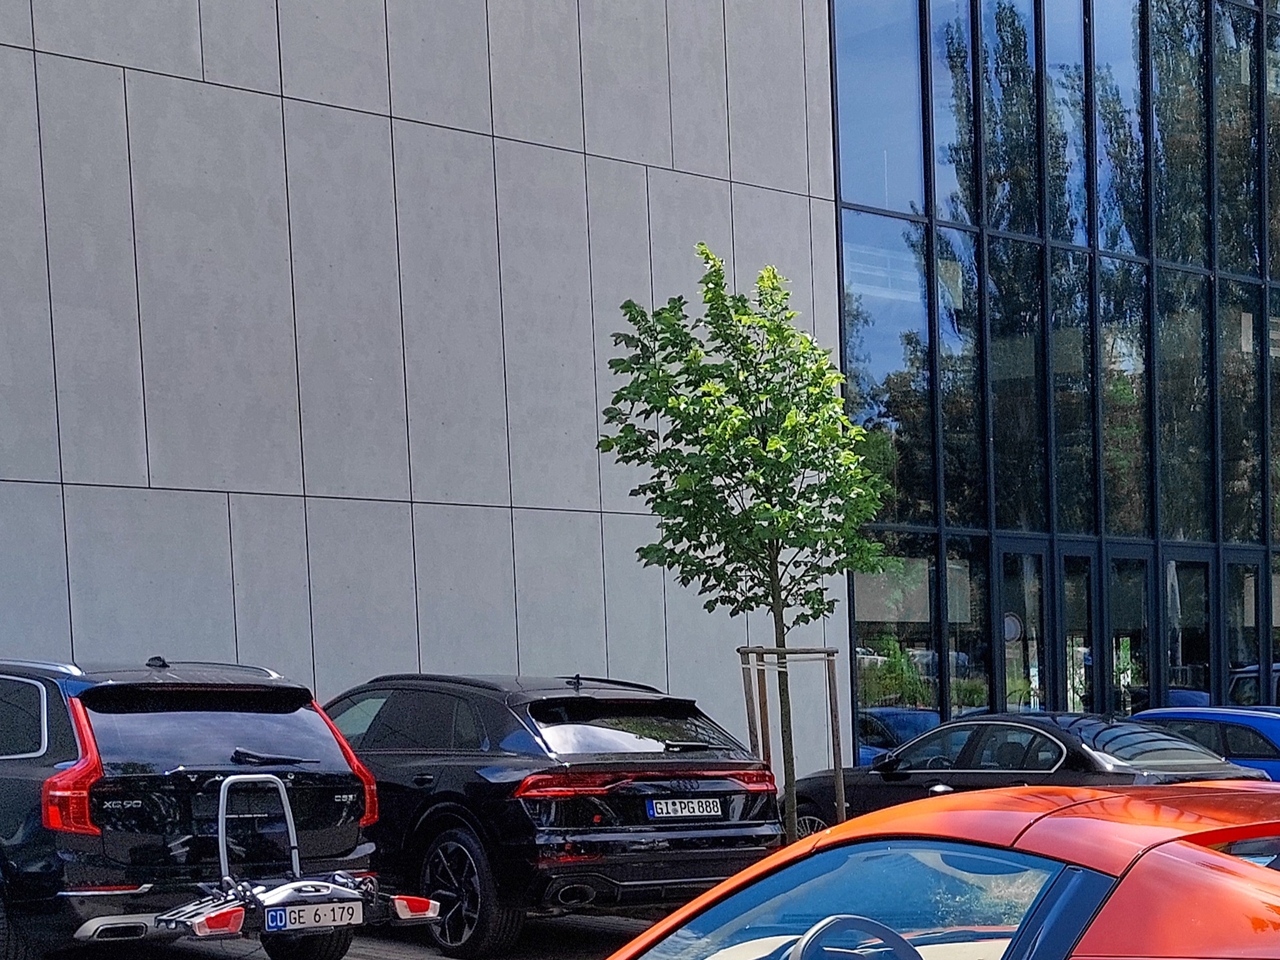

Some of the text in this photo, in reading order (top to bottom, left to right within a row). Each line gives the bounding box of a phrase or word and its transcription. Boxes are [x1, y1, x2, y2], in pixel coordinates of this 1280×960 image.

[655, 801, 671, 815] GI
[678, 801, 695, 814] PG
[697, 800, 719, 814] 888
[268, 911, 286, 927] CD
[289, 909, 306, 925] GE
